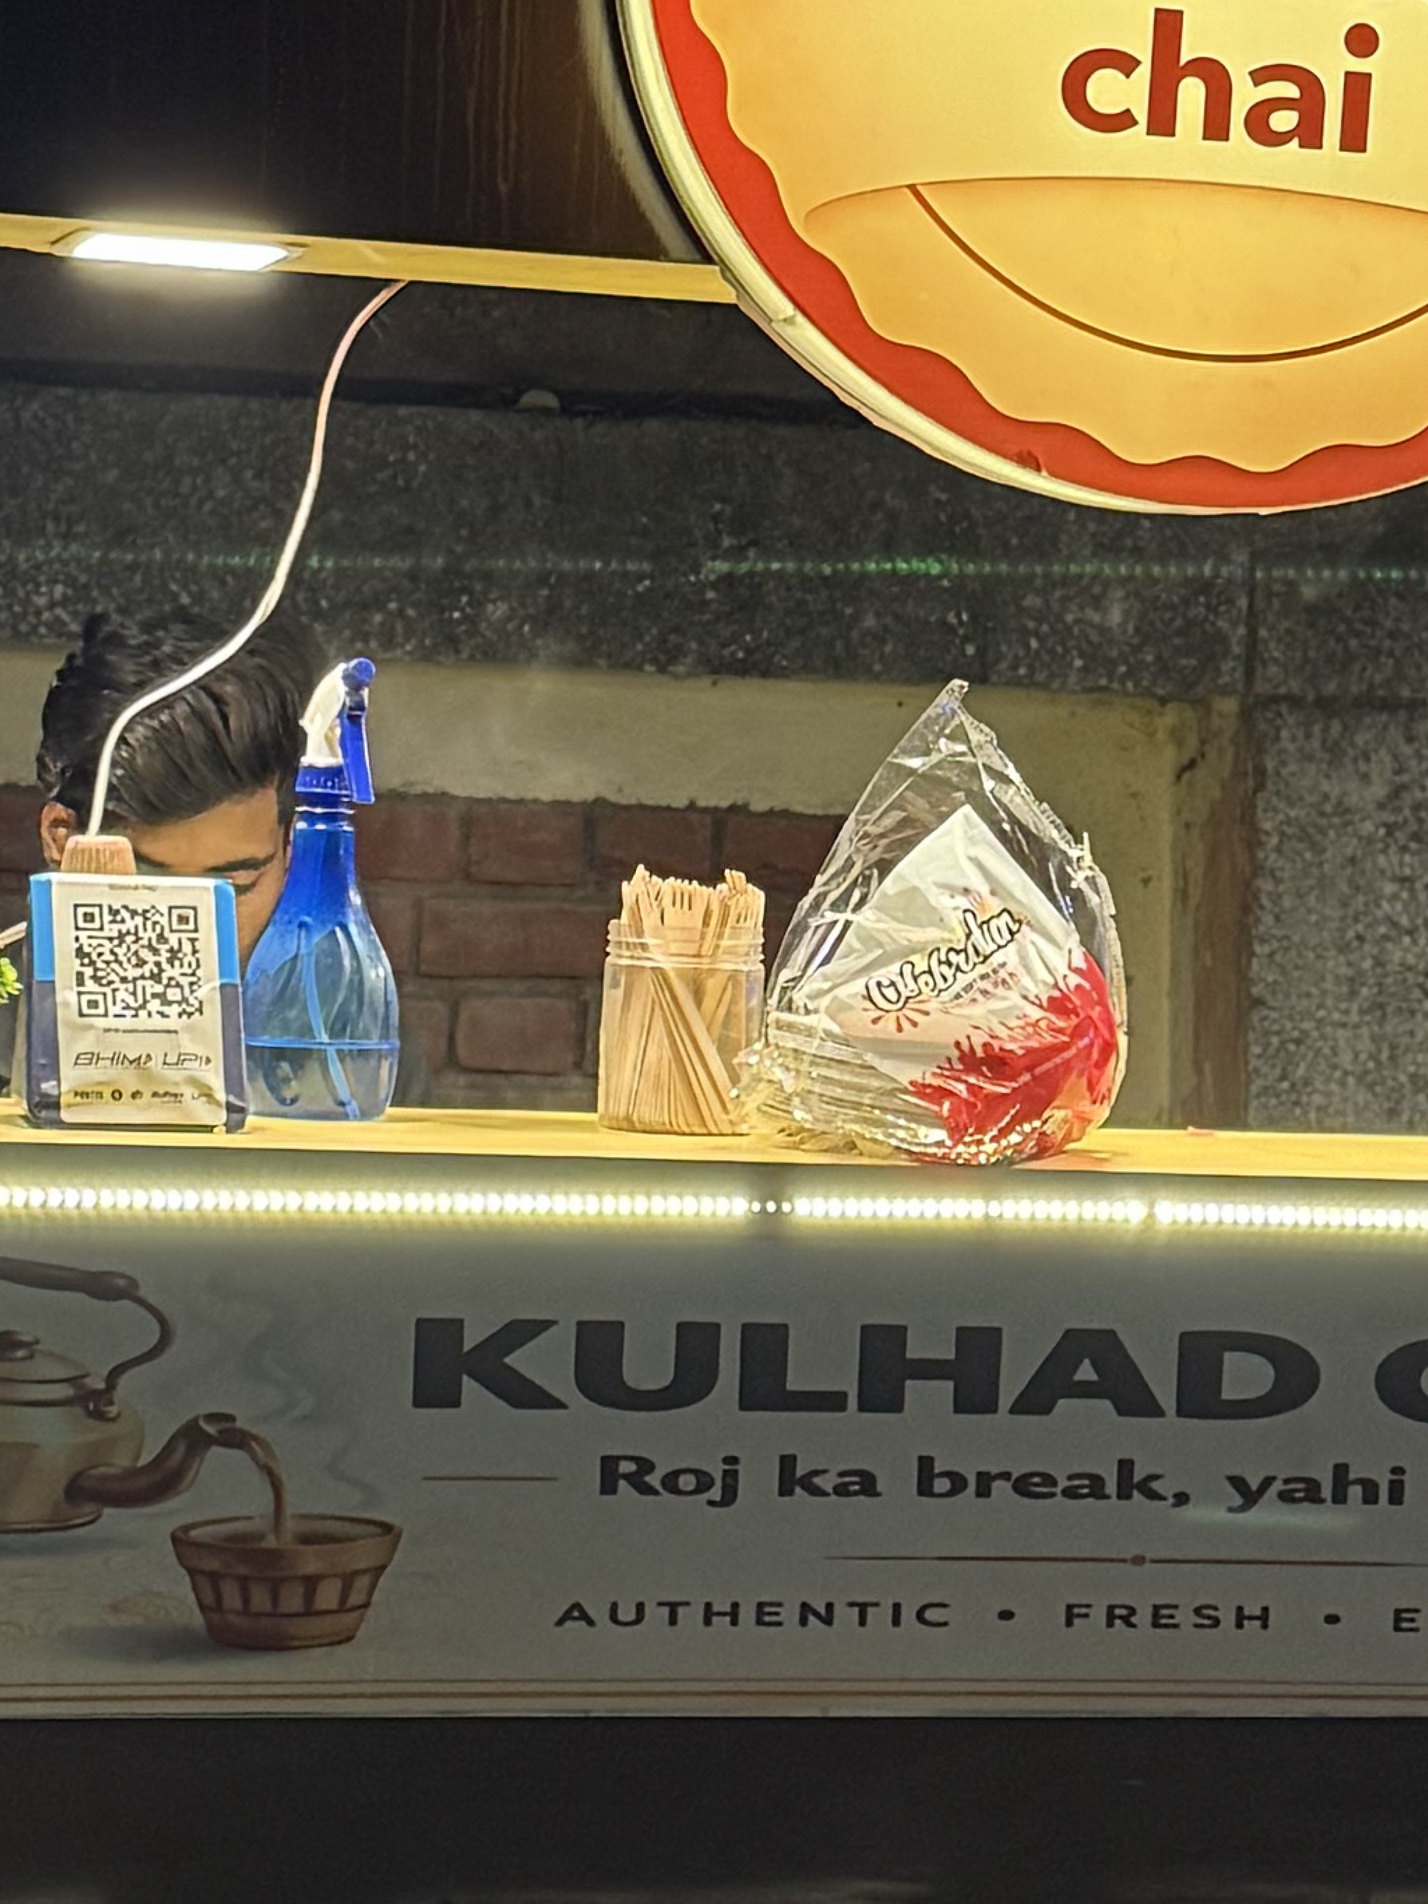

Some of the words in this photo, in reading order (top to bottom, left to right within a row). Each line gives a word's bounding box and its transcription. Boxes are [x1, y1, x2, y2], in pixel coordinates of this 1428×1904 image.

[1061, 8, 1379, 153] chai
[412, 1318, 1321, 1421] KULHAD
[599, 1455, 740, 1508] Roj
[778, 1455, 882, 1499] ka
[916, 1456, 1191, 1508] break,
[1225, 1463, 1406, 1514] yahi
[554, 1601, 952, 1629] AUTHENTIC
[1065, 1604, 1271, 1631] FRESH
